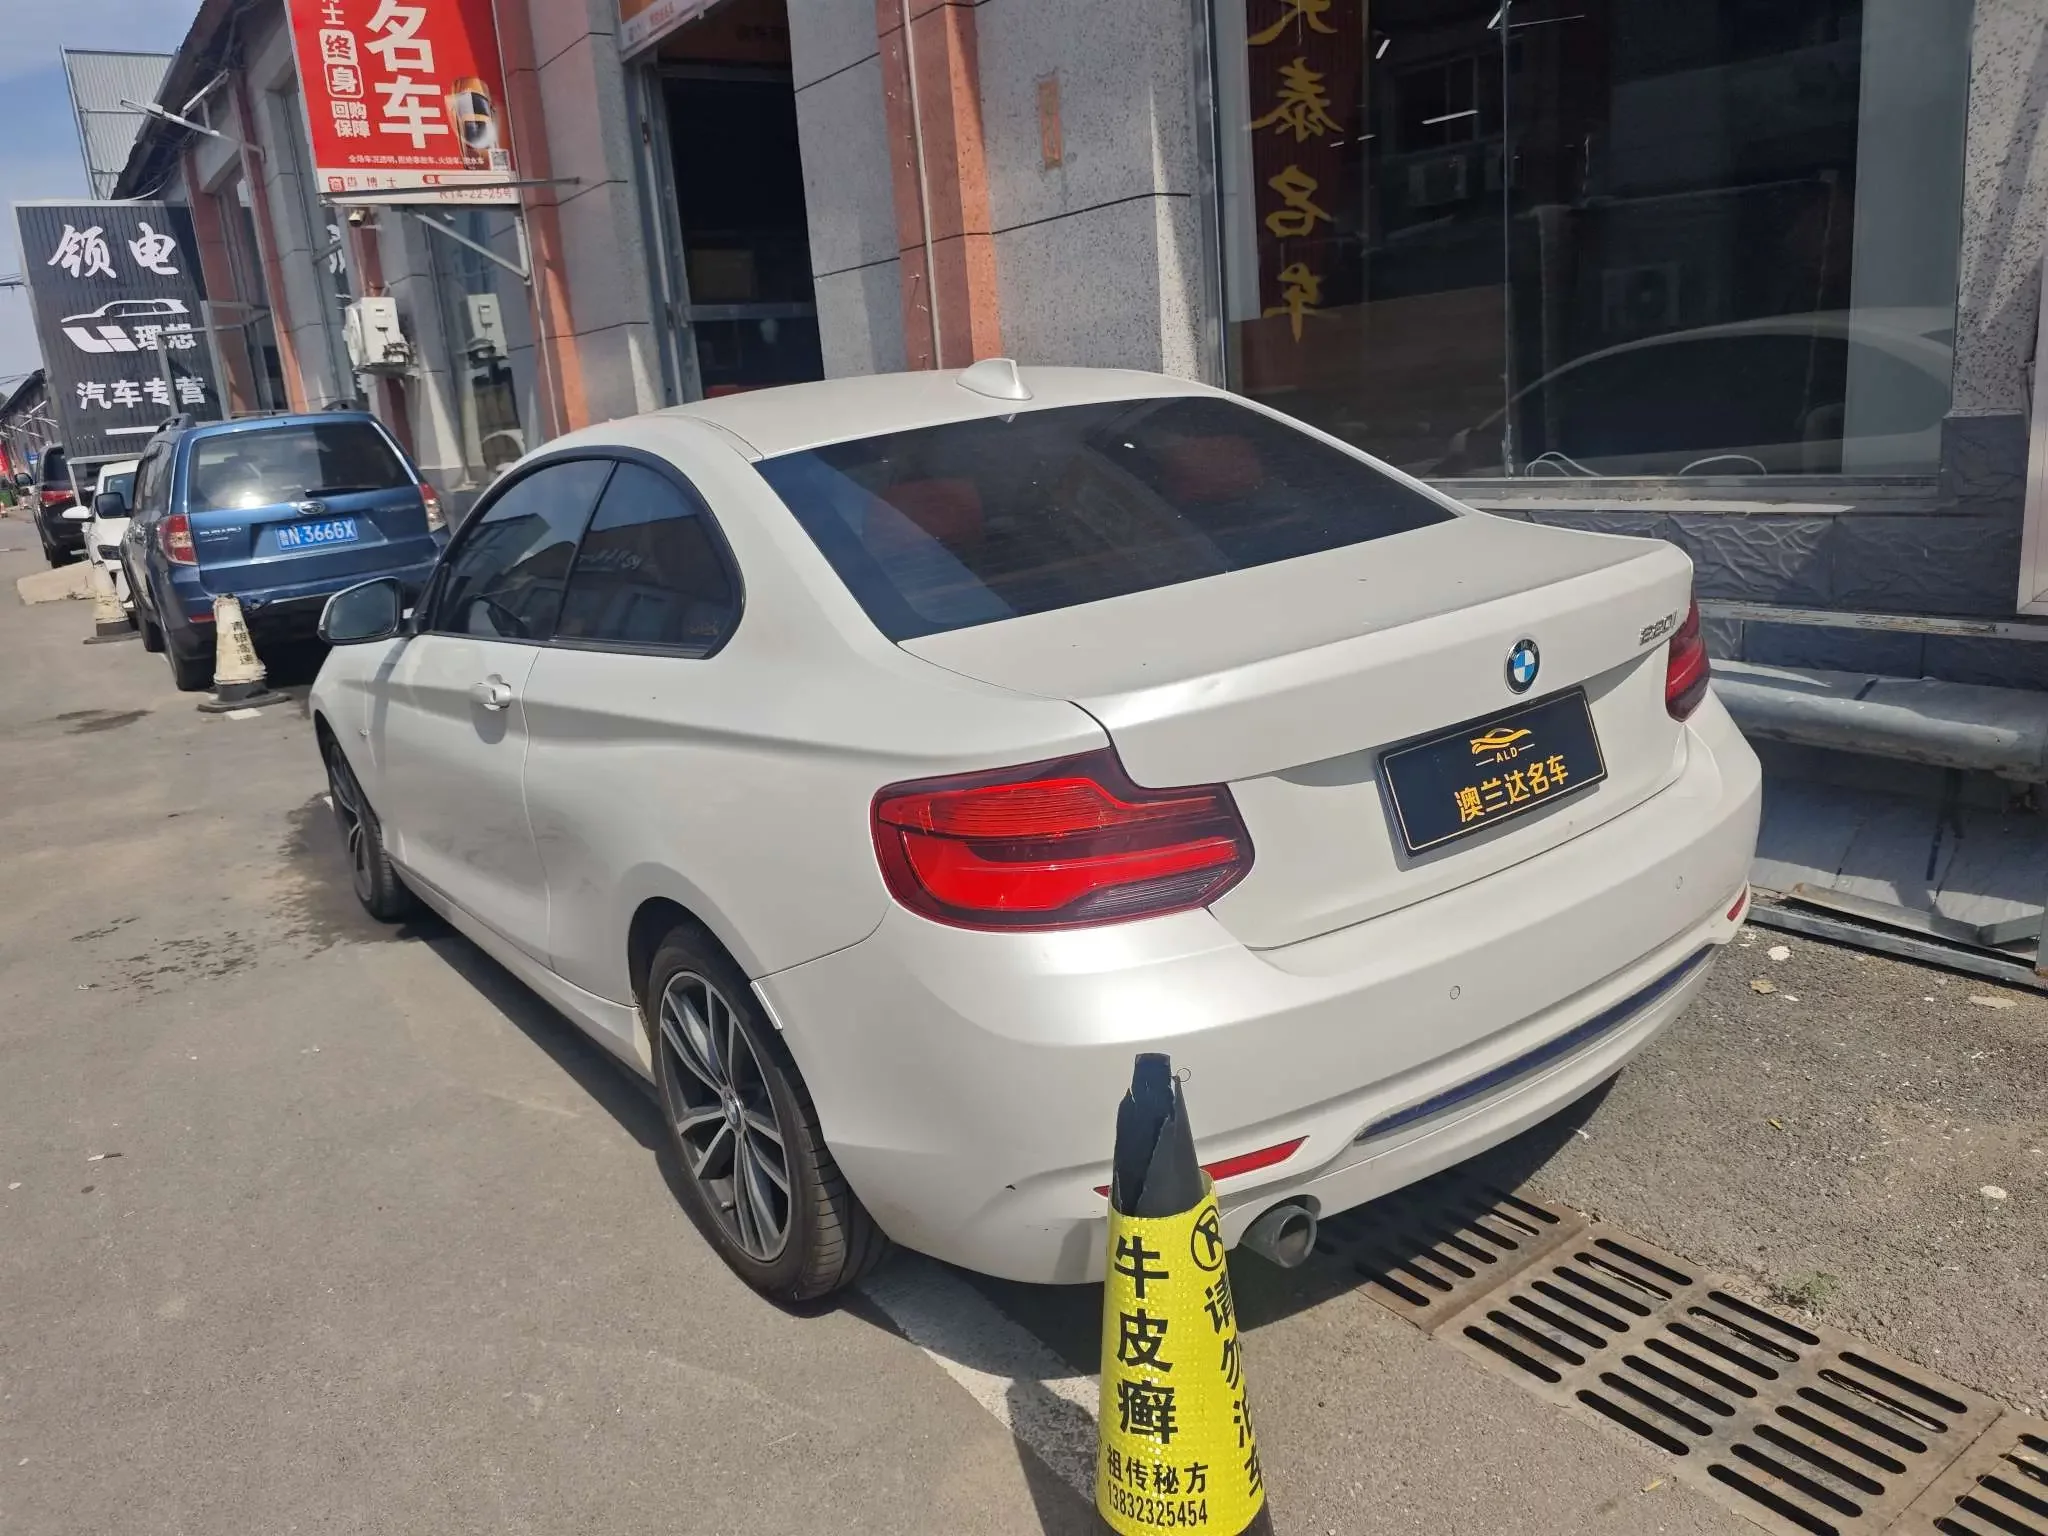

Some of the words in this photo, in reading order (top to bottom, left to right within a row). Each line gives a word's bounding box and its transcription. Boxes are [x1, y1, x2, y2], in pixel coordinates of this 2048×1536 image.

[325, 34, 358, 95] 终身
[364, 0, 449, 149] 名车
[331, 100, 367, 120] 回购
[333, 118, 371, 139] 保障
[48, 221, 180, 279] 领电
[76, 376, 207, 410] 汽车专营
[1496, 747, 1518, 763] ALD
[1454, 755, 1569, 823] 澳兰达名车
[1114, 1235, 1179, 1444] 牛皮癣
[1107, 1443, 1209, 1495] 祖传秘方
[1107, 1479, 1208, 1528] 13832325454
